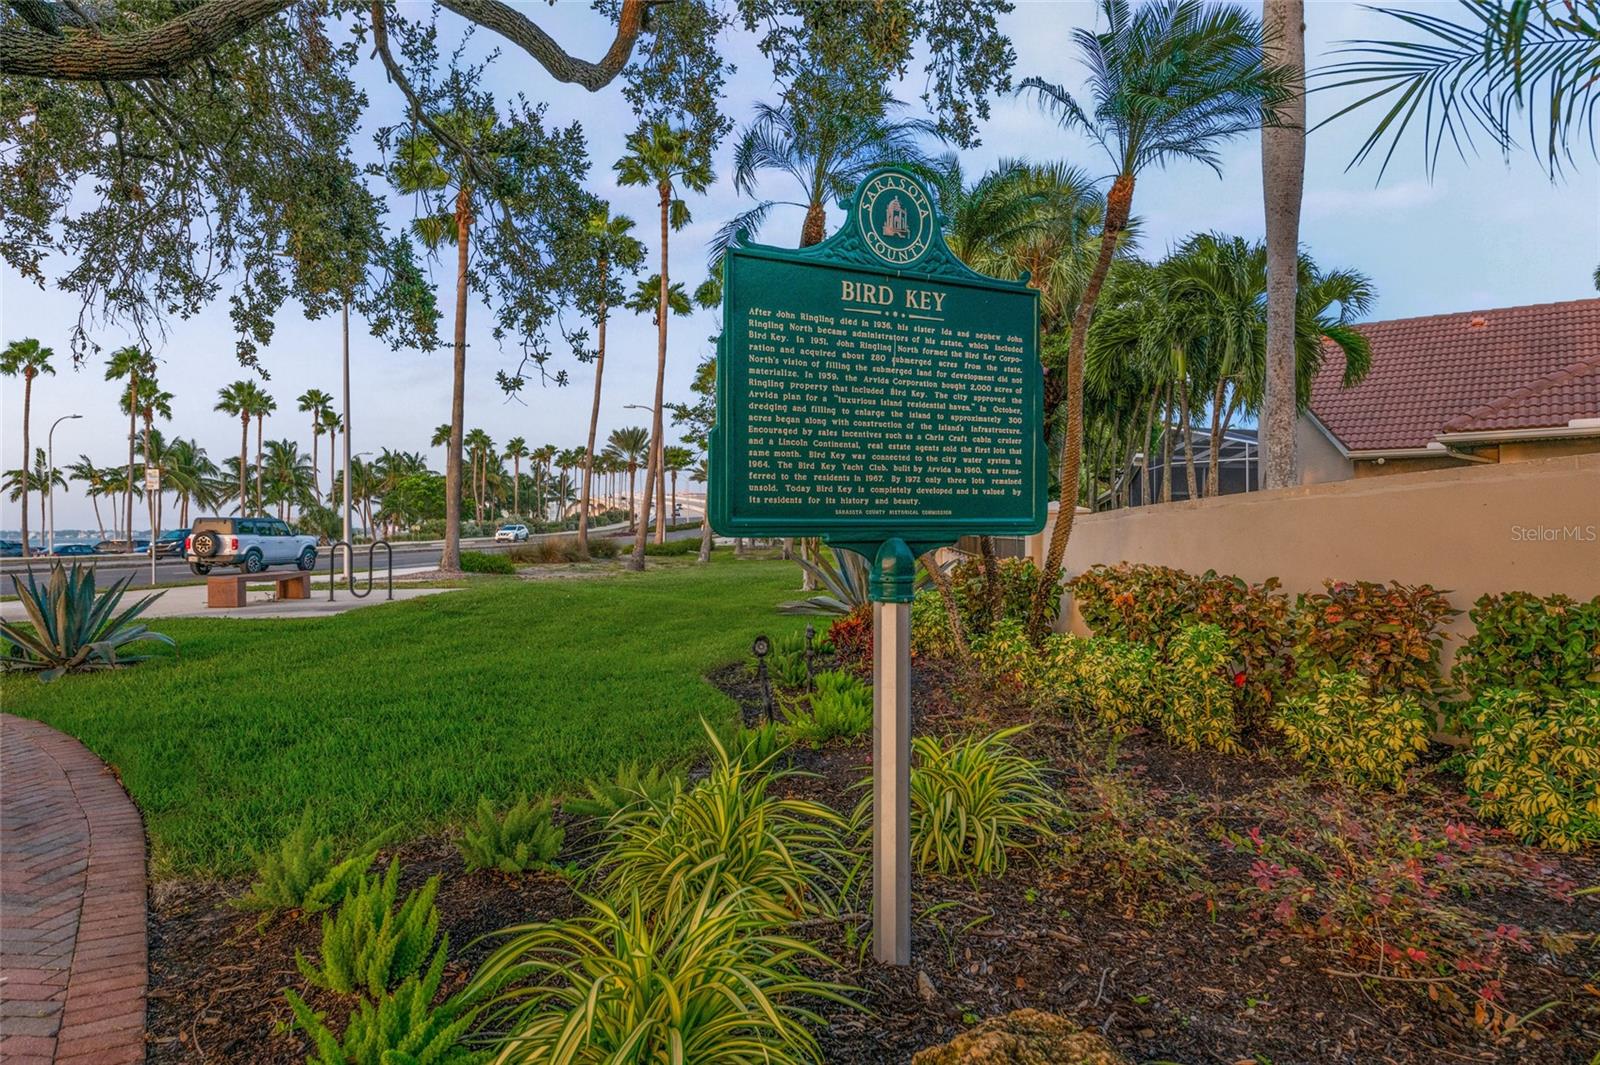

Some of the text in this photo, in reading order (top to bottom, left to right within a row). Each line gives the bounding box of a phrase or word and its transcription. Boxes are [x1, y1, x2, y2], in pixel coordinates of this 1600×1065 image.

[862, 177, 929, 218] SARASOTA
[867, 231, 925, 261] COUNTY
[841, 281, 946, 312] BIRD KEY
[748, 319, 783, 331] Ringling
[789, 322, 812, 332] North
[817, 326, 846, 336] became
[852, 330, 908, 342] administrators
[749, 307, 1022, 343] After John Ringling died his sister Ida and John
[748, 330, 766, 339] Bird
[836, 339, 854, 347] John
[859, 341, 891, 352] Ringling
[898, 345, 918, 353] North
[922, 347, 947, 356] formed
[964, 351, 979, 359] Bird
[983, 353, 995, 361] Key
[999, 354, 1021, 363] Corpo-
[749, 343, 774, 352] ration
[800, 348, 835, 357] acquired
[842, 351, 864, 359] about
[871, 353, 885, 362] 280
[964, 361, 980, 370] from
[748, 354, 778, 364] North's
[783, 357, 807, 366] vision
[825, 360, 850, 371] filling
[855, 363, 867, 371] the
[872, 364, 912, 376] submerged
[916, 368, 931, 376] land
[936, 370, 946, 378] for
[748, 378, 784, 389] Ringling
[790, 382, 827, 391] property
[832, 384, 847, 392] that
[851, 386, 883, 394] included
[890, 387, 906, 396] Bird
[935, 391, 947, 399] The
[953, 393, 967, 401] city
[863, 375, 888, 384] Arvida
[892, 377, 937, 387] Corporation
[748, 390, 778, 399] Arvida
[783, 392, 800, 401] plan
[805, 393, 817, 401] for
[834, 395, 875, 405] "luxurious
[880, 398, 902, 407] island
[907, 401, 945, 409] residential
[748, 402, 787, 412] dredging
[811, 405, 835, 416] filling
[854, 408, 884, 418] enlarge
[909, 411, 930, 419] island
[1008, 416, 1022, 424] 300
[775, 415, 800, 424] began
[805, 416, 826, 426] along
[853, 420, 901, 428] construction
[920, 422, 931, 430] the
[938, 423, 963, 431] island's
[748, 425, 797, 435] Encouraged
[842, 430, 881, 438] incentives
[925, 433, 943, 441] Chris
[948, 434, 966, 442] Craft
[972, 435, 991, 443] cabin
[778, 438, 807, 446] Lincoln
[777, 460, 792, 468] The
[798, 461, 814, 469] Bird
[821, 462, 835, 471] Key
[842, 463, 863, 471] Yacht
[893, 464, 910, 472] built
[809, 450, 825, 458] Bird
[830, 451, 845, 460] Key
[942, 455, 956, 463] city
[749, 471, 775, 480] ferred
[905, 475, 920, 483] 1972
[925, 476, 940, 484] only
[947, 476, 966, 484] three
[785, 484, 810, 493] Today
[837, 485, 851, 494] Key
[870, 486, 911, 494] completely
[916, 487, 952, 495] developed
[808, 496, 819, 504] for
[825, 496, 835, 504] its
[840, 497, 868, 505] history
